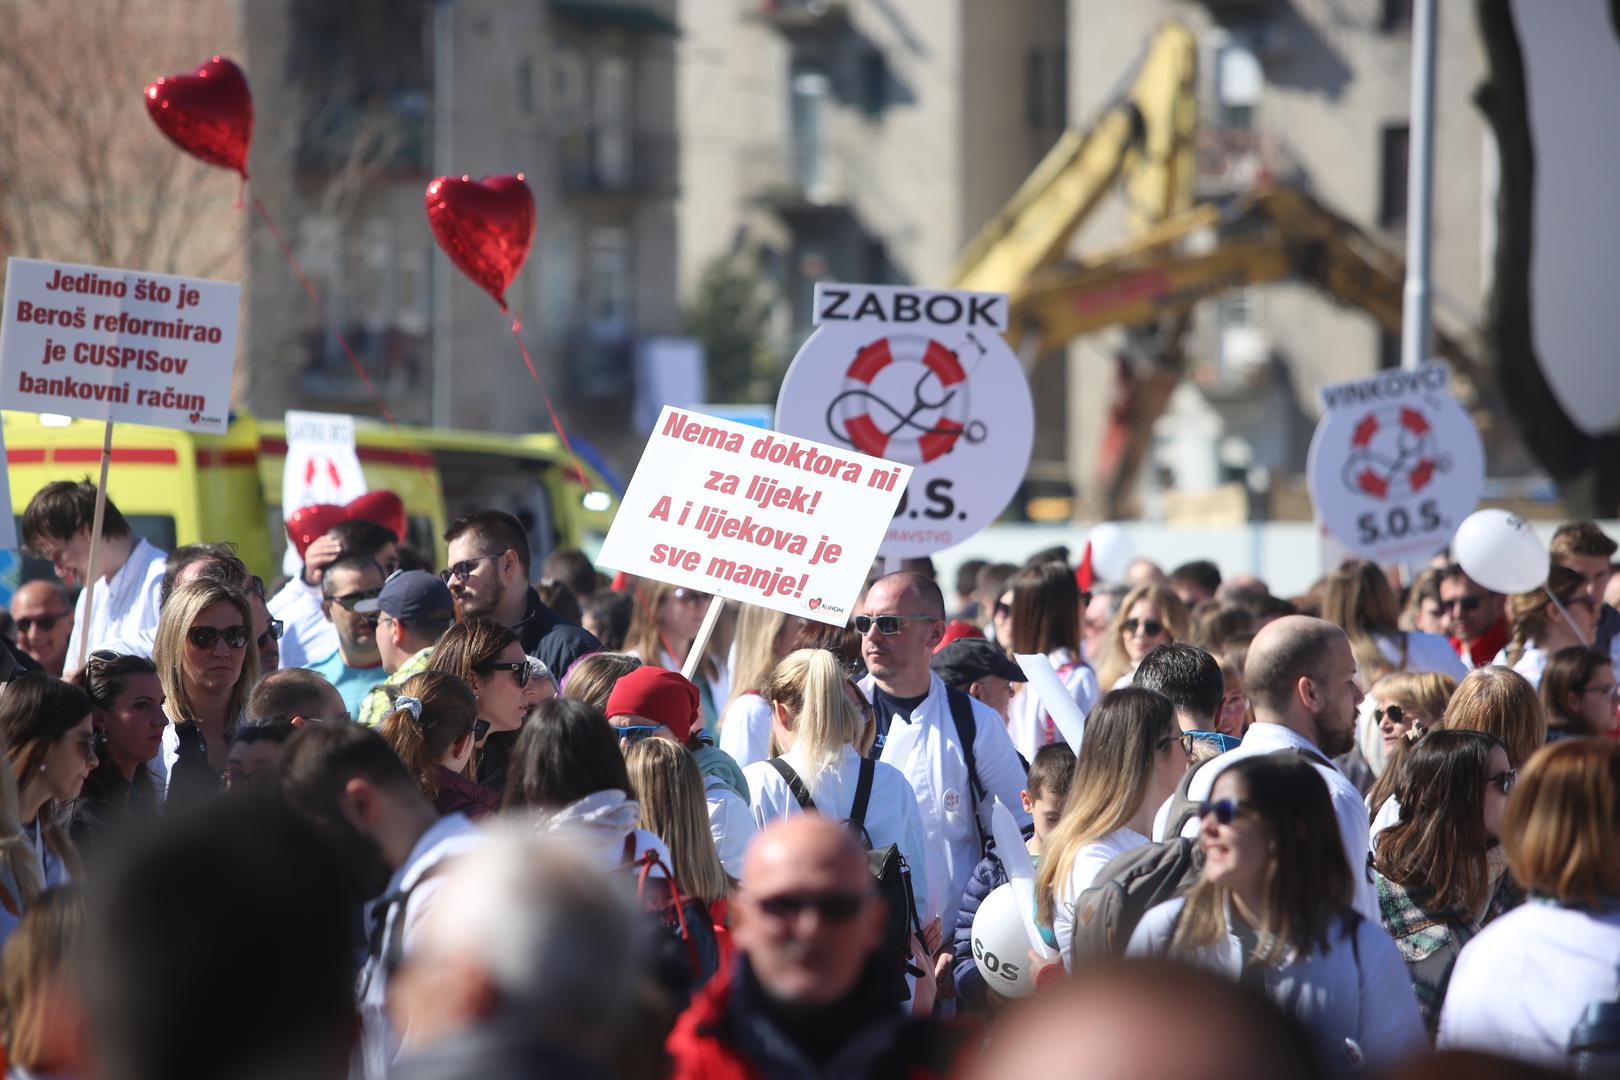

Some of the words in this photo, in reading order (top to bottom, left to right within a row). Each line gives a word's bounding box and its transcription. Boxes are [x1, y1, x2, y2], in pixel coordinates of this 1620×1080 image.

[46, 270, 127, 297] Jedino
[134, 278, 171, 303] što
[176, 284, 200, 309] je
[821, 290, 1000, 327] ZABOK
[17, 301, 85, 328] Beroš
[93, 313, 222, 343] reformirao
[42, 340, 66, 364] je
[73, 342, 188, 374] CUSPISov
[19, 372, 130, 404] bankovni
[136, 387, 206, 411] račun
[662, 412, 745, 454] Nema
[750, 435, 863, 483] doktora
[867, 467, 901, 492] ni
[703, 470, 741, 495] za
[746, 475, 823, 515] lijek!
[648, 495, 672, 522] A
[677, 501, 693, 526] i
[695, 505, 809, 556] lijekova
[808, 535, 843, 565] je
[649, 543, 701, 572] sve
[705, 556, 810, 599] manje!
[973, 938, 1020, 981] SOS
